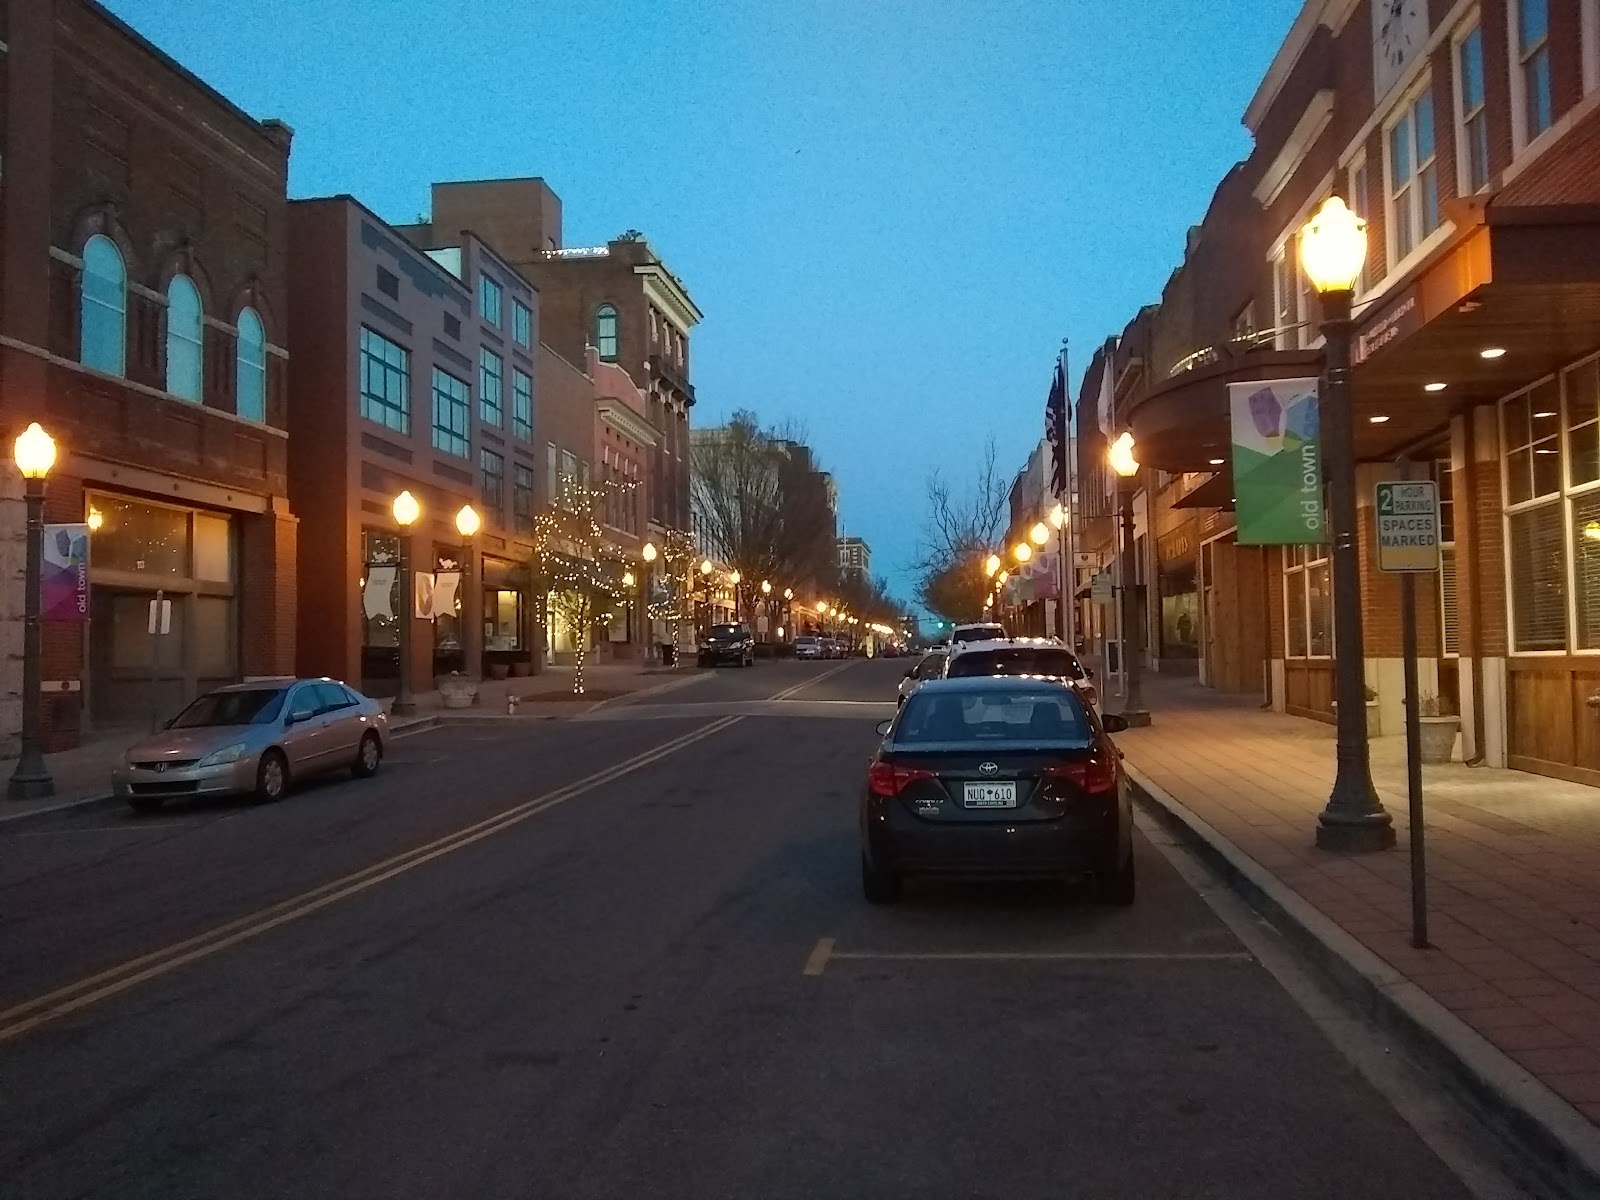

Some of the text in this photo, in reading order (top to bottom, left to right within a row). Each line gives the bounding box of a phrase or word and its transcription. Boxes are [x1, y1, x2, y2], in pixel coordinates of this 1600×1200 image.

[1300, 444, 1319, 530] old town
[1401, 487, 1424, 498] HOUR
[1379, 488, 1393, 511] 2
[1395, 500, 1431, 511] PARKING
[1383, 519, 1432, 531] SPACES
[1382, 535, 1435, 546] MARKED
[77, 562, 87, 613] old town
[994, 788, 1012, 800] 610
